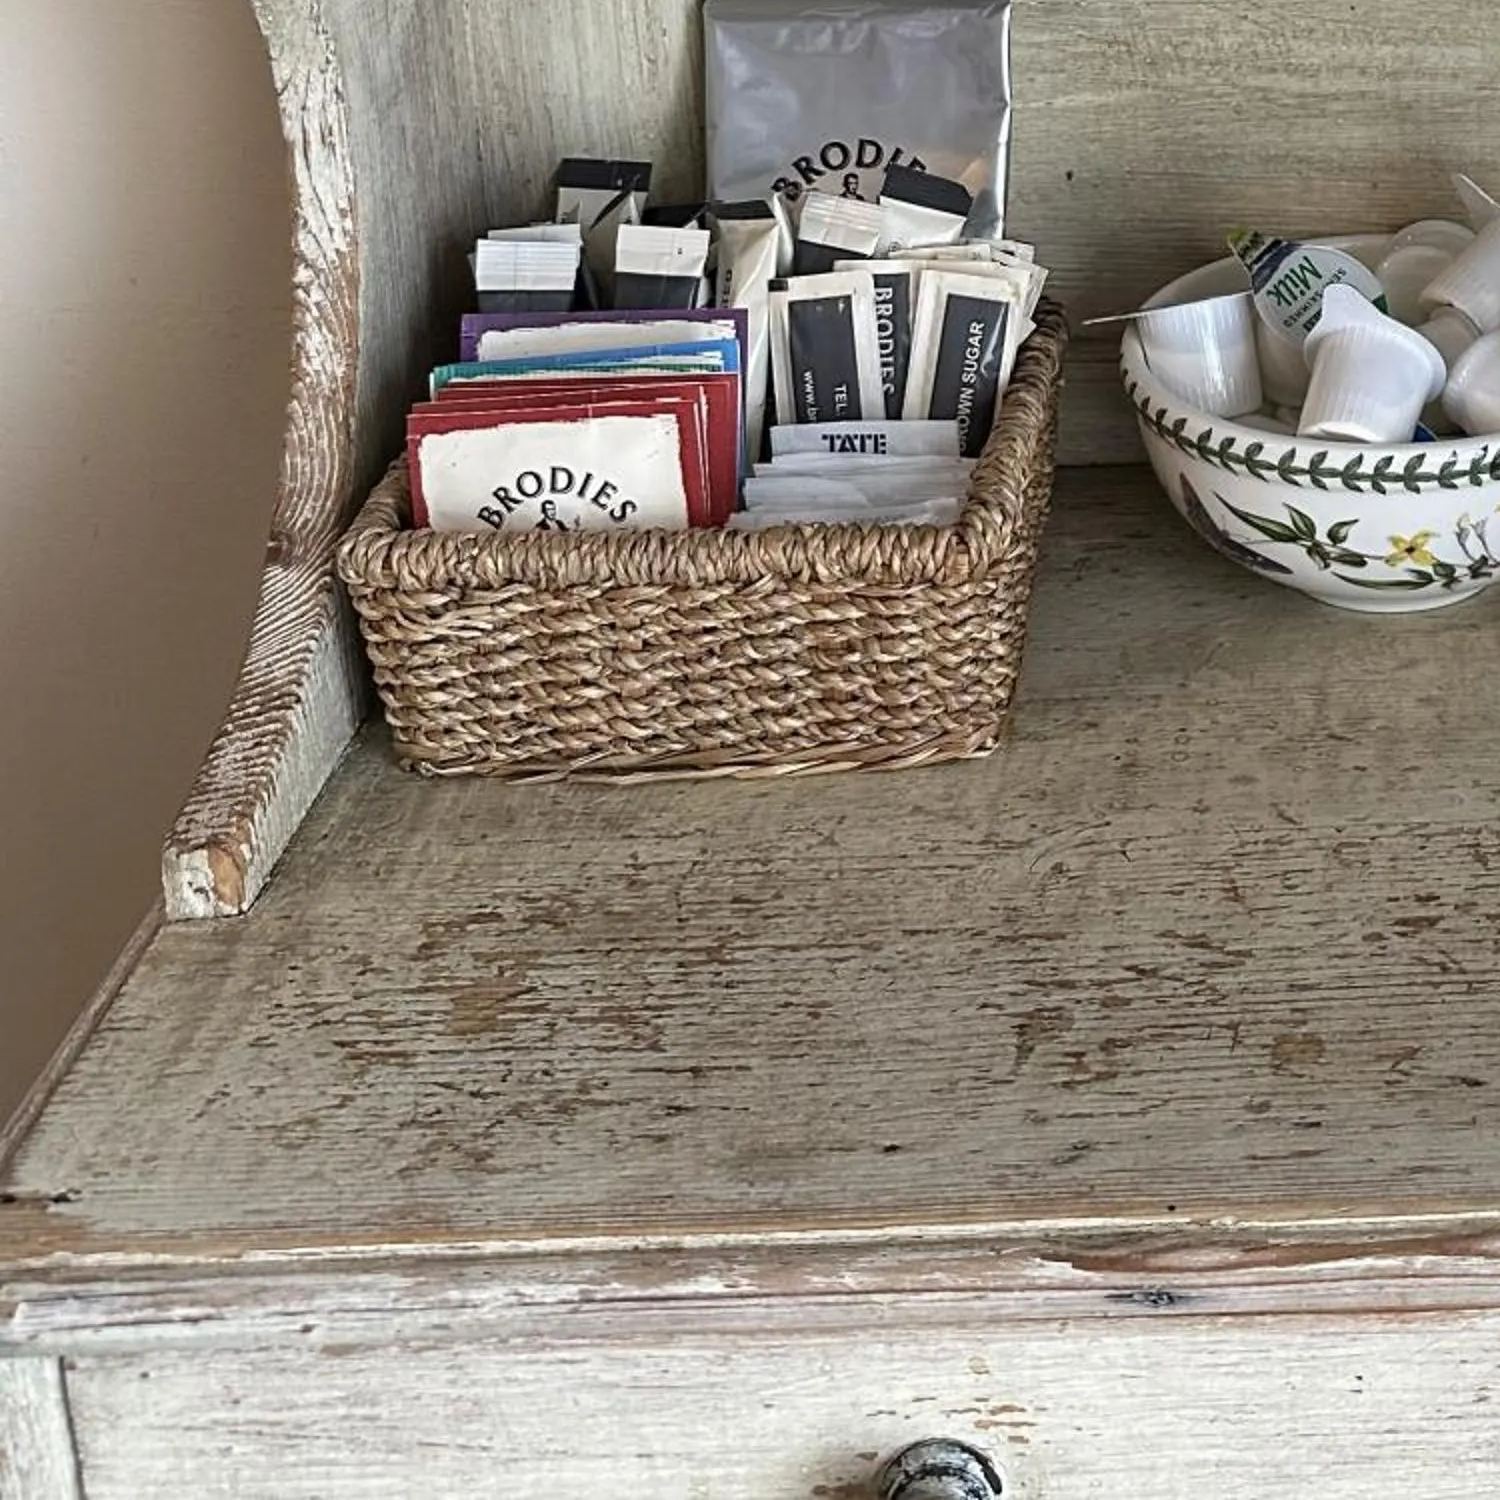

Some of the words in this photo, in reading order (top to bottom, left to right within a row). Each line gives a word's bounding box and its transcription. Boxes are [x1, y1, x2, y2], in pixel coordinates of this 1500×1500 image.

[1266, 255, 1323, 307] Milk
[961, 321, 985, 383] SUGAR
[821, 433, 887, 455] TATE
[475, 465, 638, 531] BRODIES
